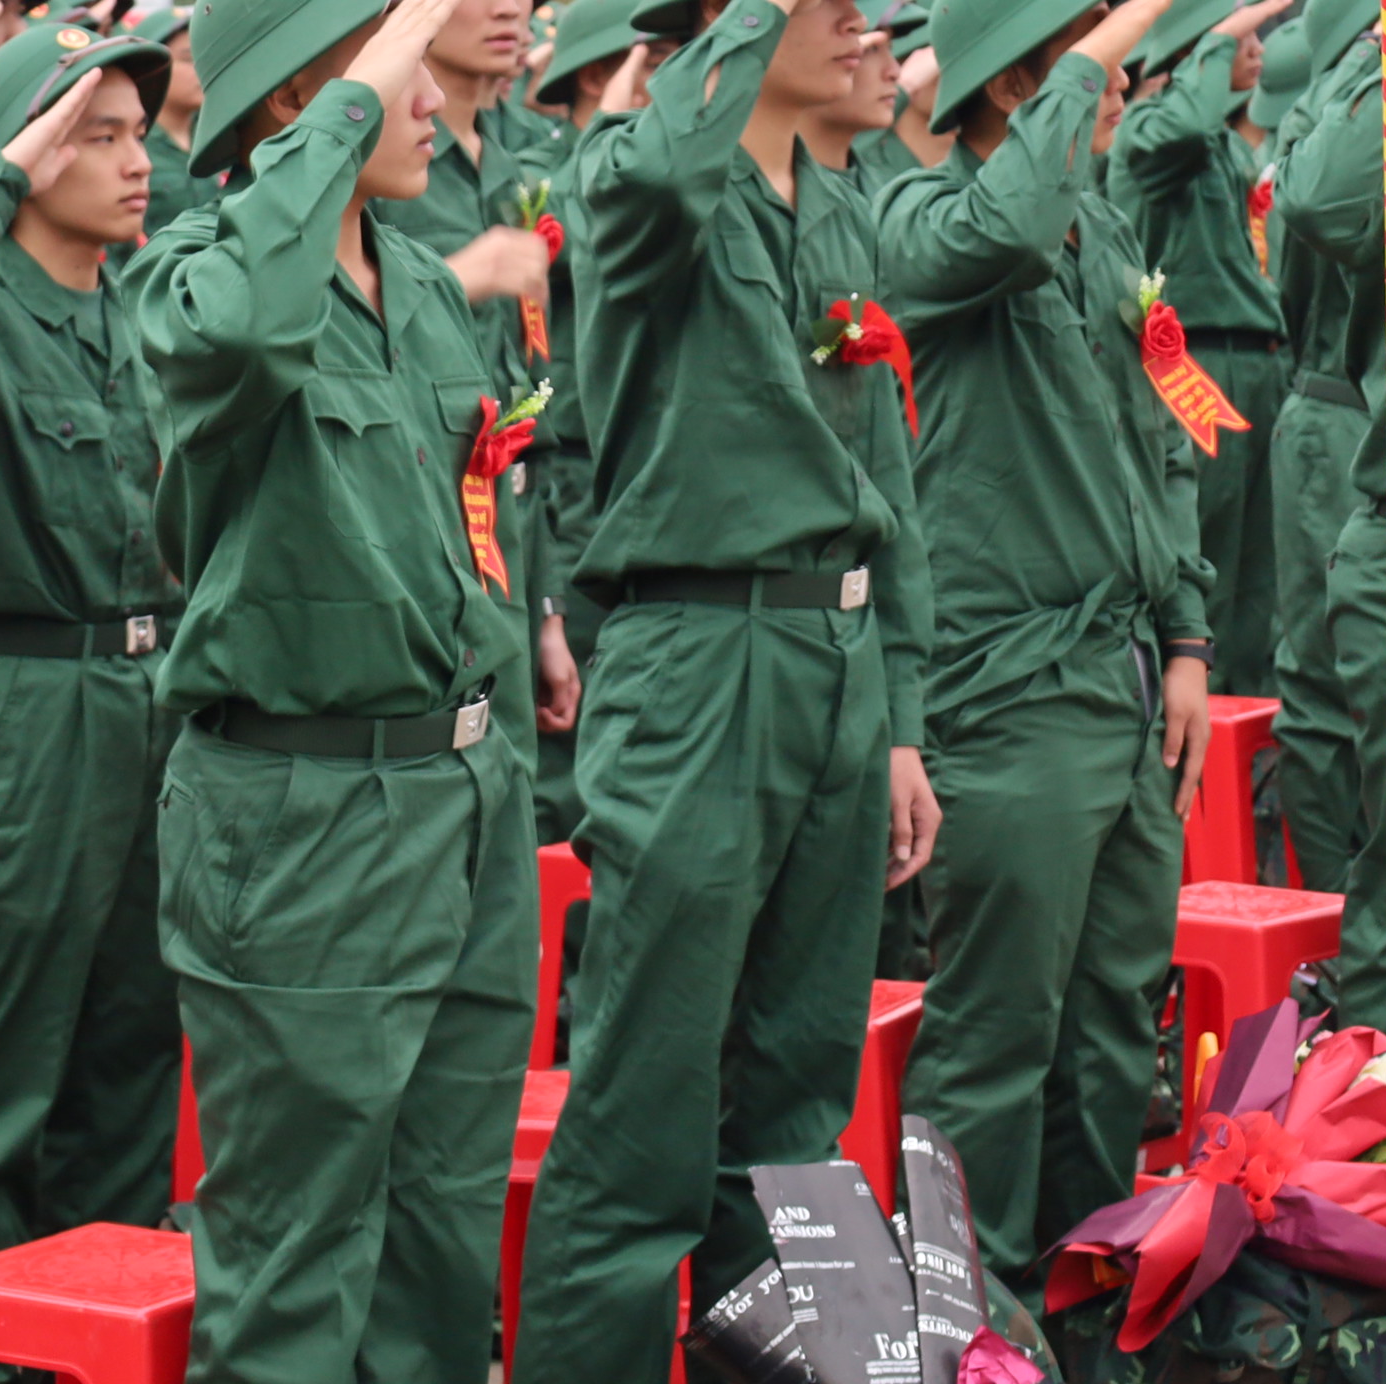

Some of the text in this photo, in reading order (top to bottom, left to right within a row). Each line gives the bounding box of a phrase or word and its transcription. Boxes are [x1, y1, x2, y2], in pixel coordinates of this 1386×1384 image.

[774, 1206, 811, 1221] AND
[725, 1292, 754, 1321] for
[757, 1268, 783, 1295] yo
